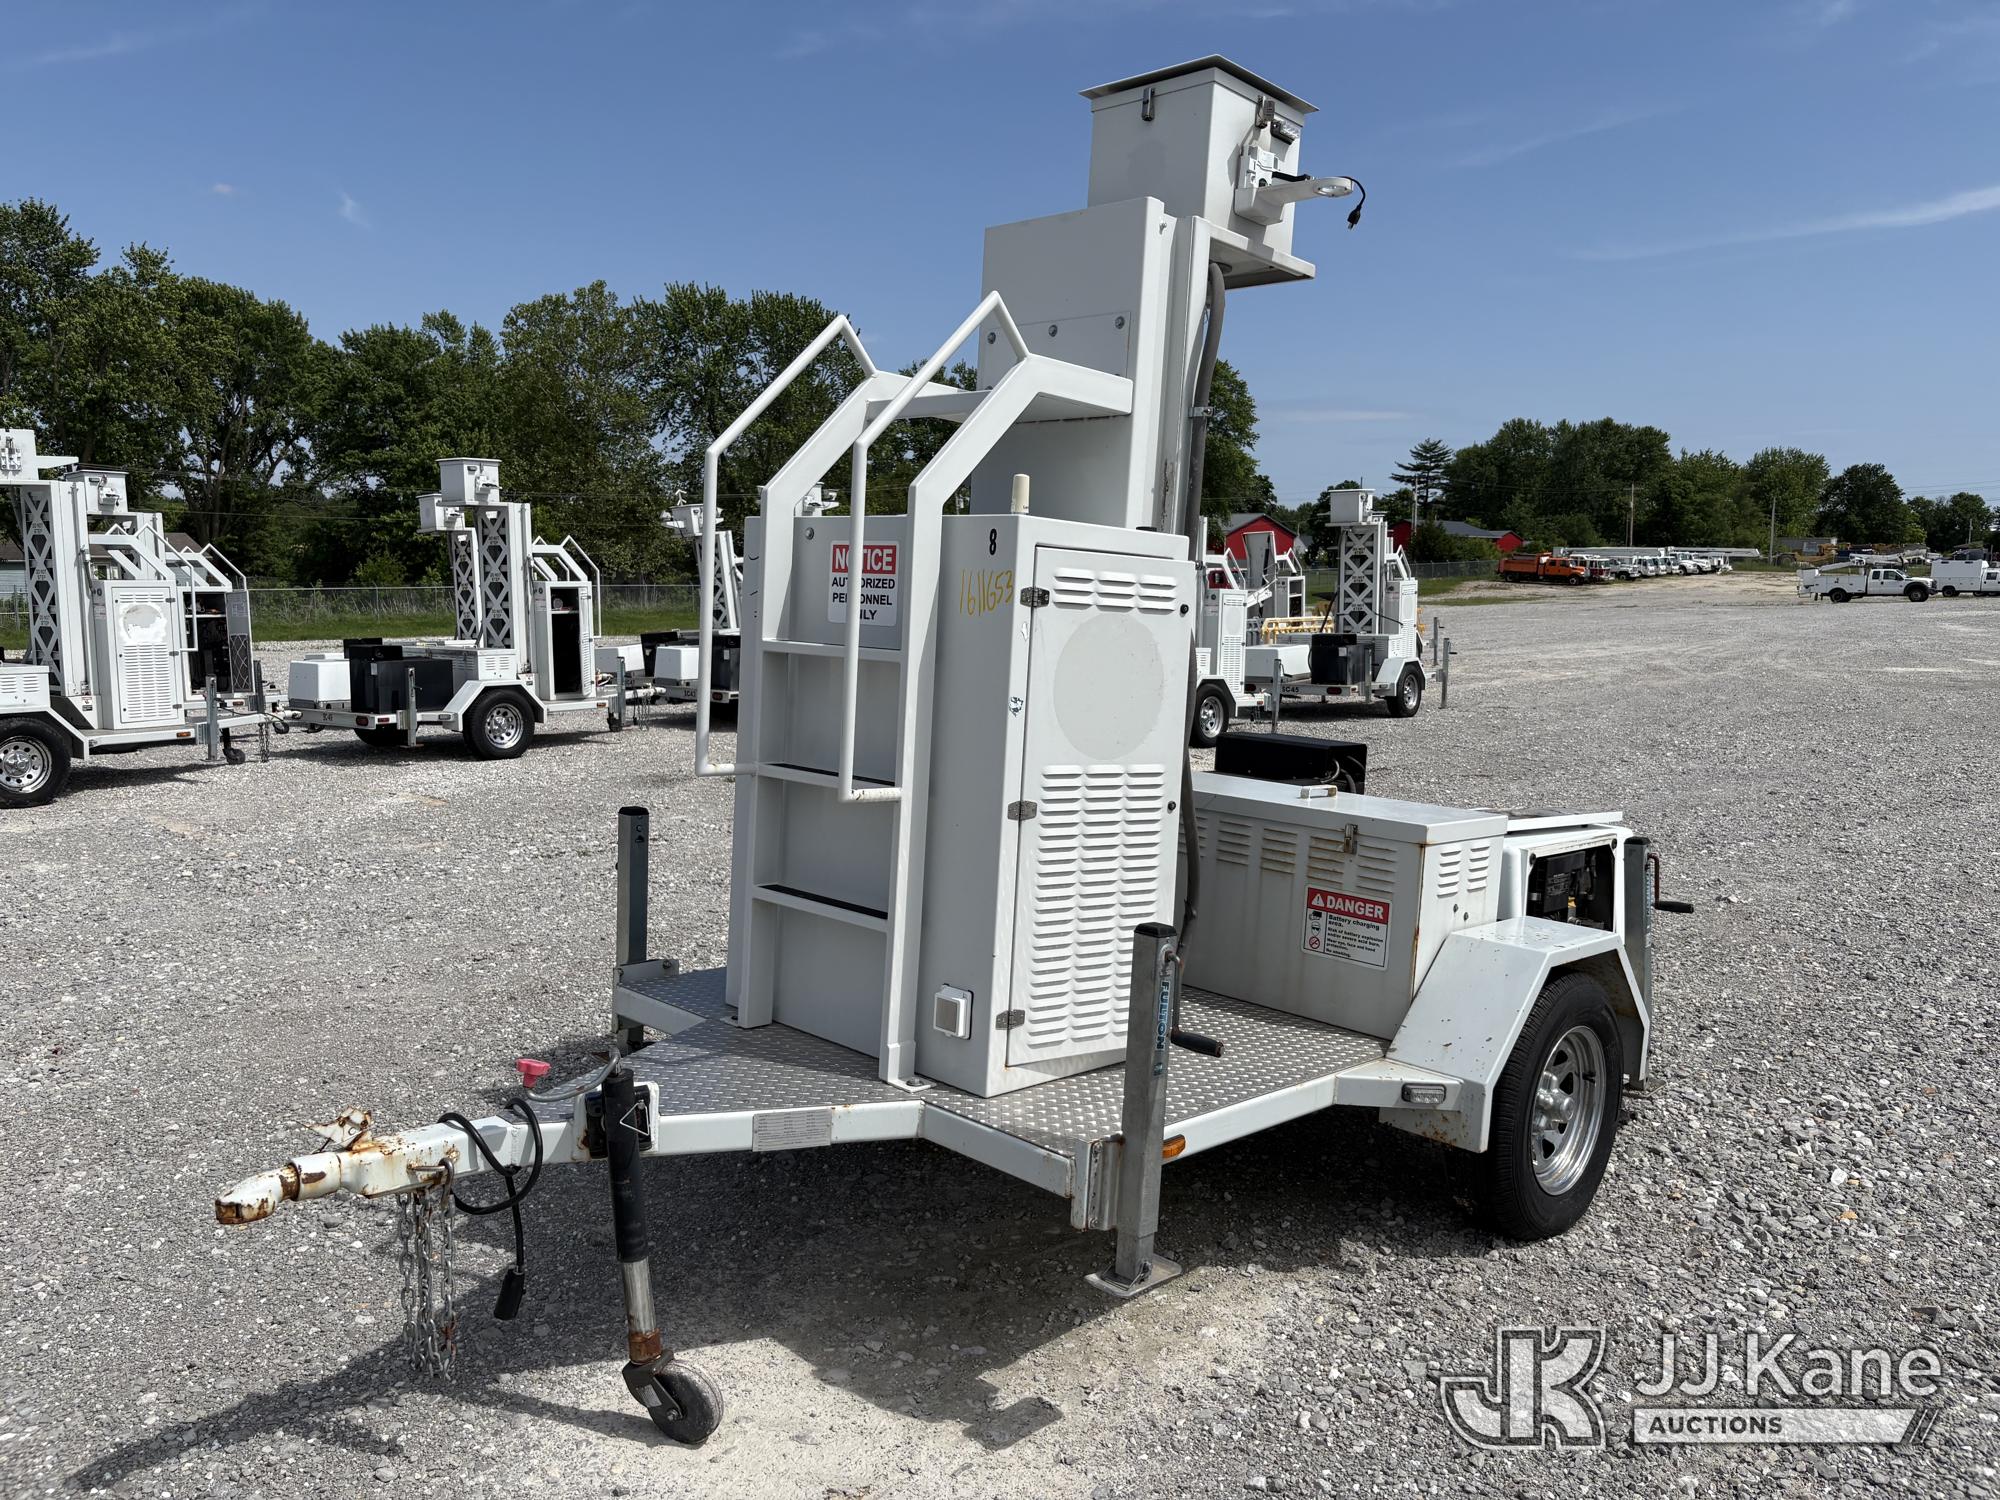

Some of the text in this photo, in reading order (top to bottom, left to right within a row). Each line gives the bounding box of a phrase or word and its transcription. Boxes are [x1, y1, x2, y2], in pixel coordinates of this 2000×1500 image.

[989, 528, 997, 555] 8
[835, 548, 893, 571] NICE
[832, 577, 895, 589] AUORIZED
[959, 569, 1013, 616] 1611653
[832, 593, 893, 606] PEONNEL
[1326, 895, 1384, 919] DANGER
[1328, 914, 1380, 931] Battery charging
[1156, 980, 1170, 1050] FULTON
